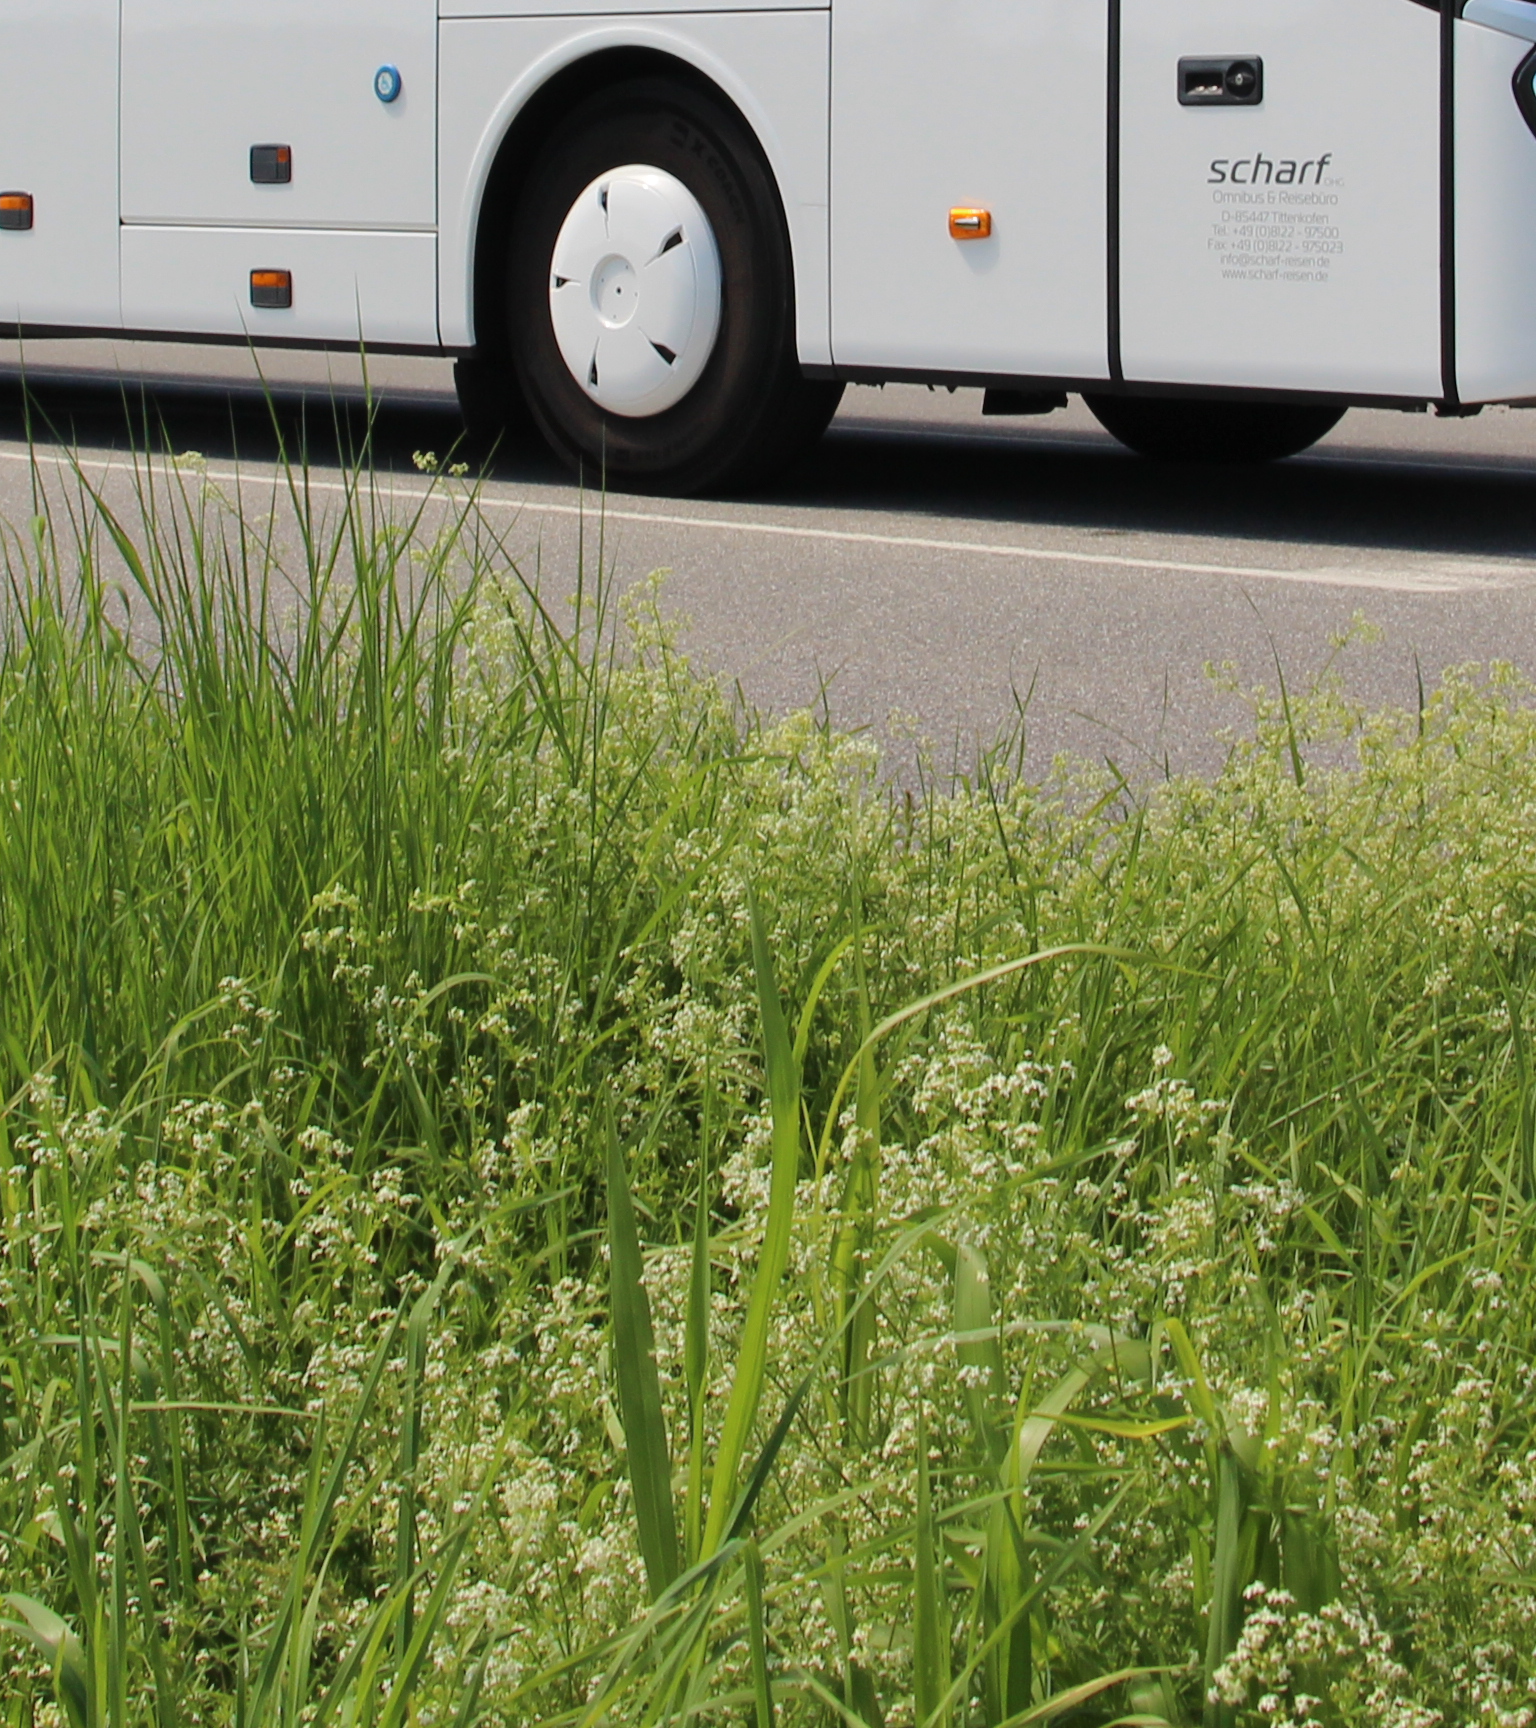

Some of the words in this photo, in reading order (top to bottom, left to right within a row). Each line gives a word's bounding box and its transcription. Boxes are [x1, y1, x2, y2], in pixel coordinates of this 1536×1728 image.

[1207, 152, 1333, 185] scharf
[1212, 190, 1265, 205] Omnibus
[1267, 191, 1276, 205] &
[1278, 190, 1339, 206] Reisebüro
[1221, 210, 1270, 223] D-85447
[1269, 211, 1330, 225] Tittenkofen
[1232, 224, 1254, 238] +49
[1304, 226, 1340, 240] 97500
[1230, 238, 1252, 252] +49
